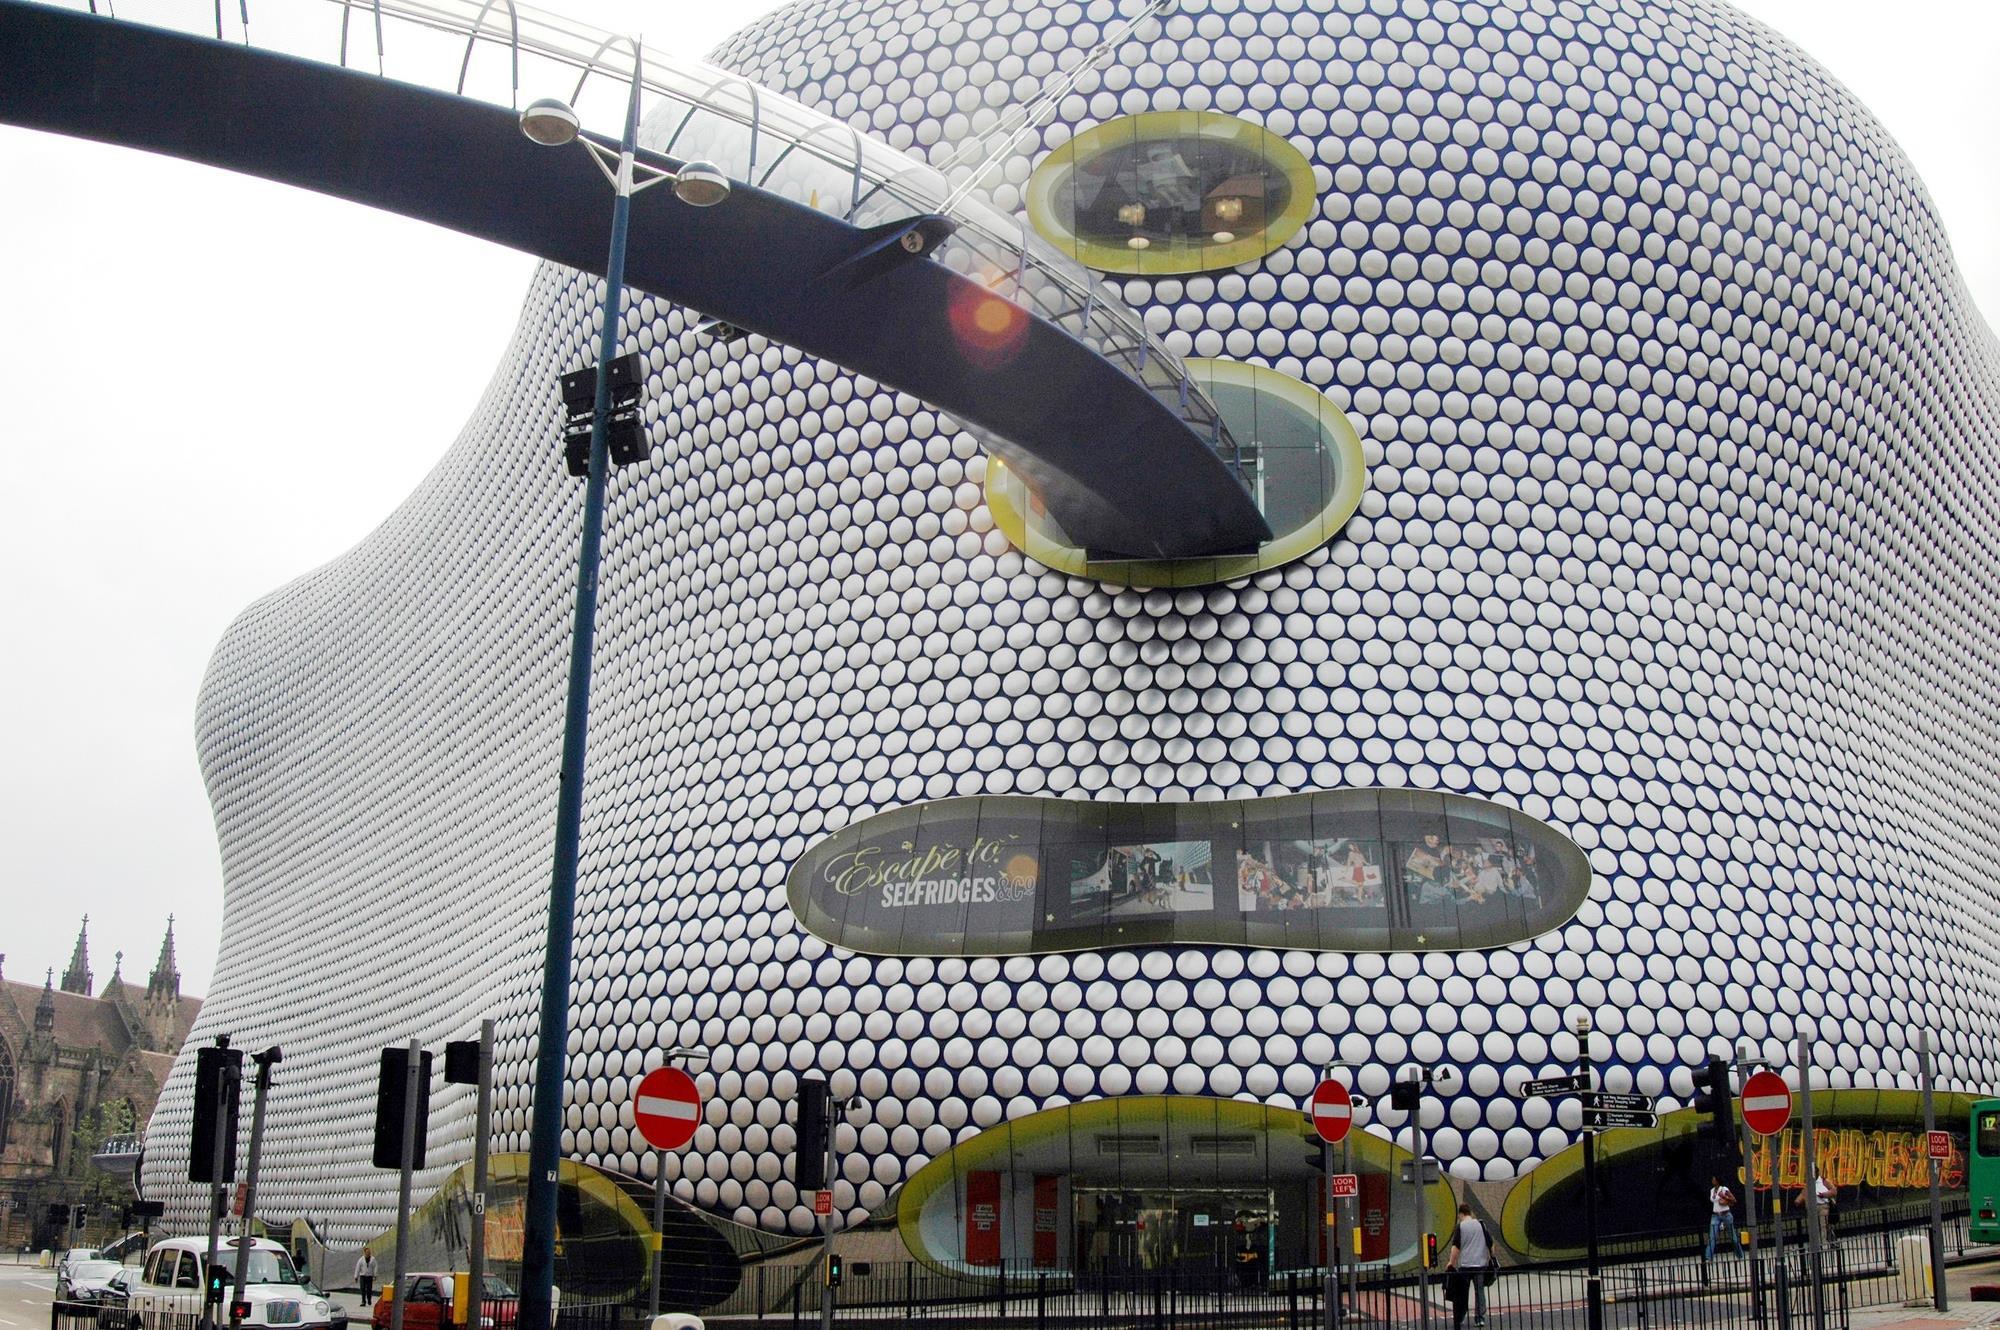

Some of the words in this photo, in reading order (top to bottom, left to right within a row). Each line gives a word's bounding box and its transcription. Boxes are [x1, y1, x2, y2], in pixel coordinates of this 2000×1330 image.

[824, 845, 960, 896] Escape
[968, 837, 1001, 865] to
[1931, 1135, 1947, 1143] LOOK
[1931, 1145, 1948, 1153] RIGHT
[549, 1171, 555, 1180] 7
